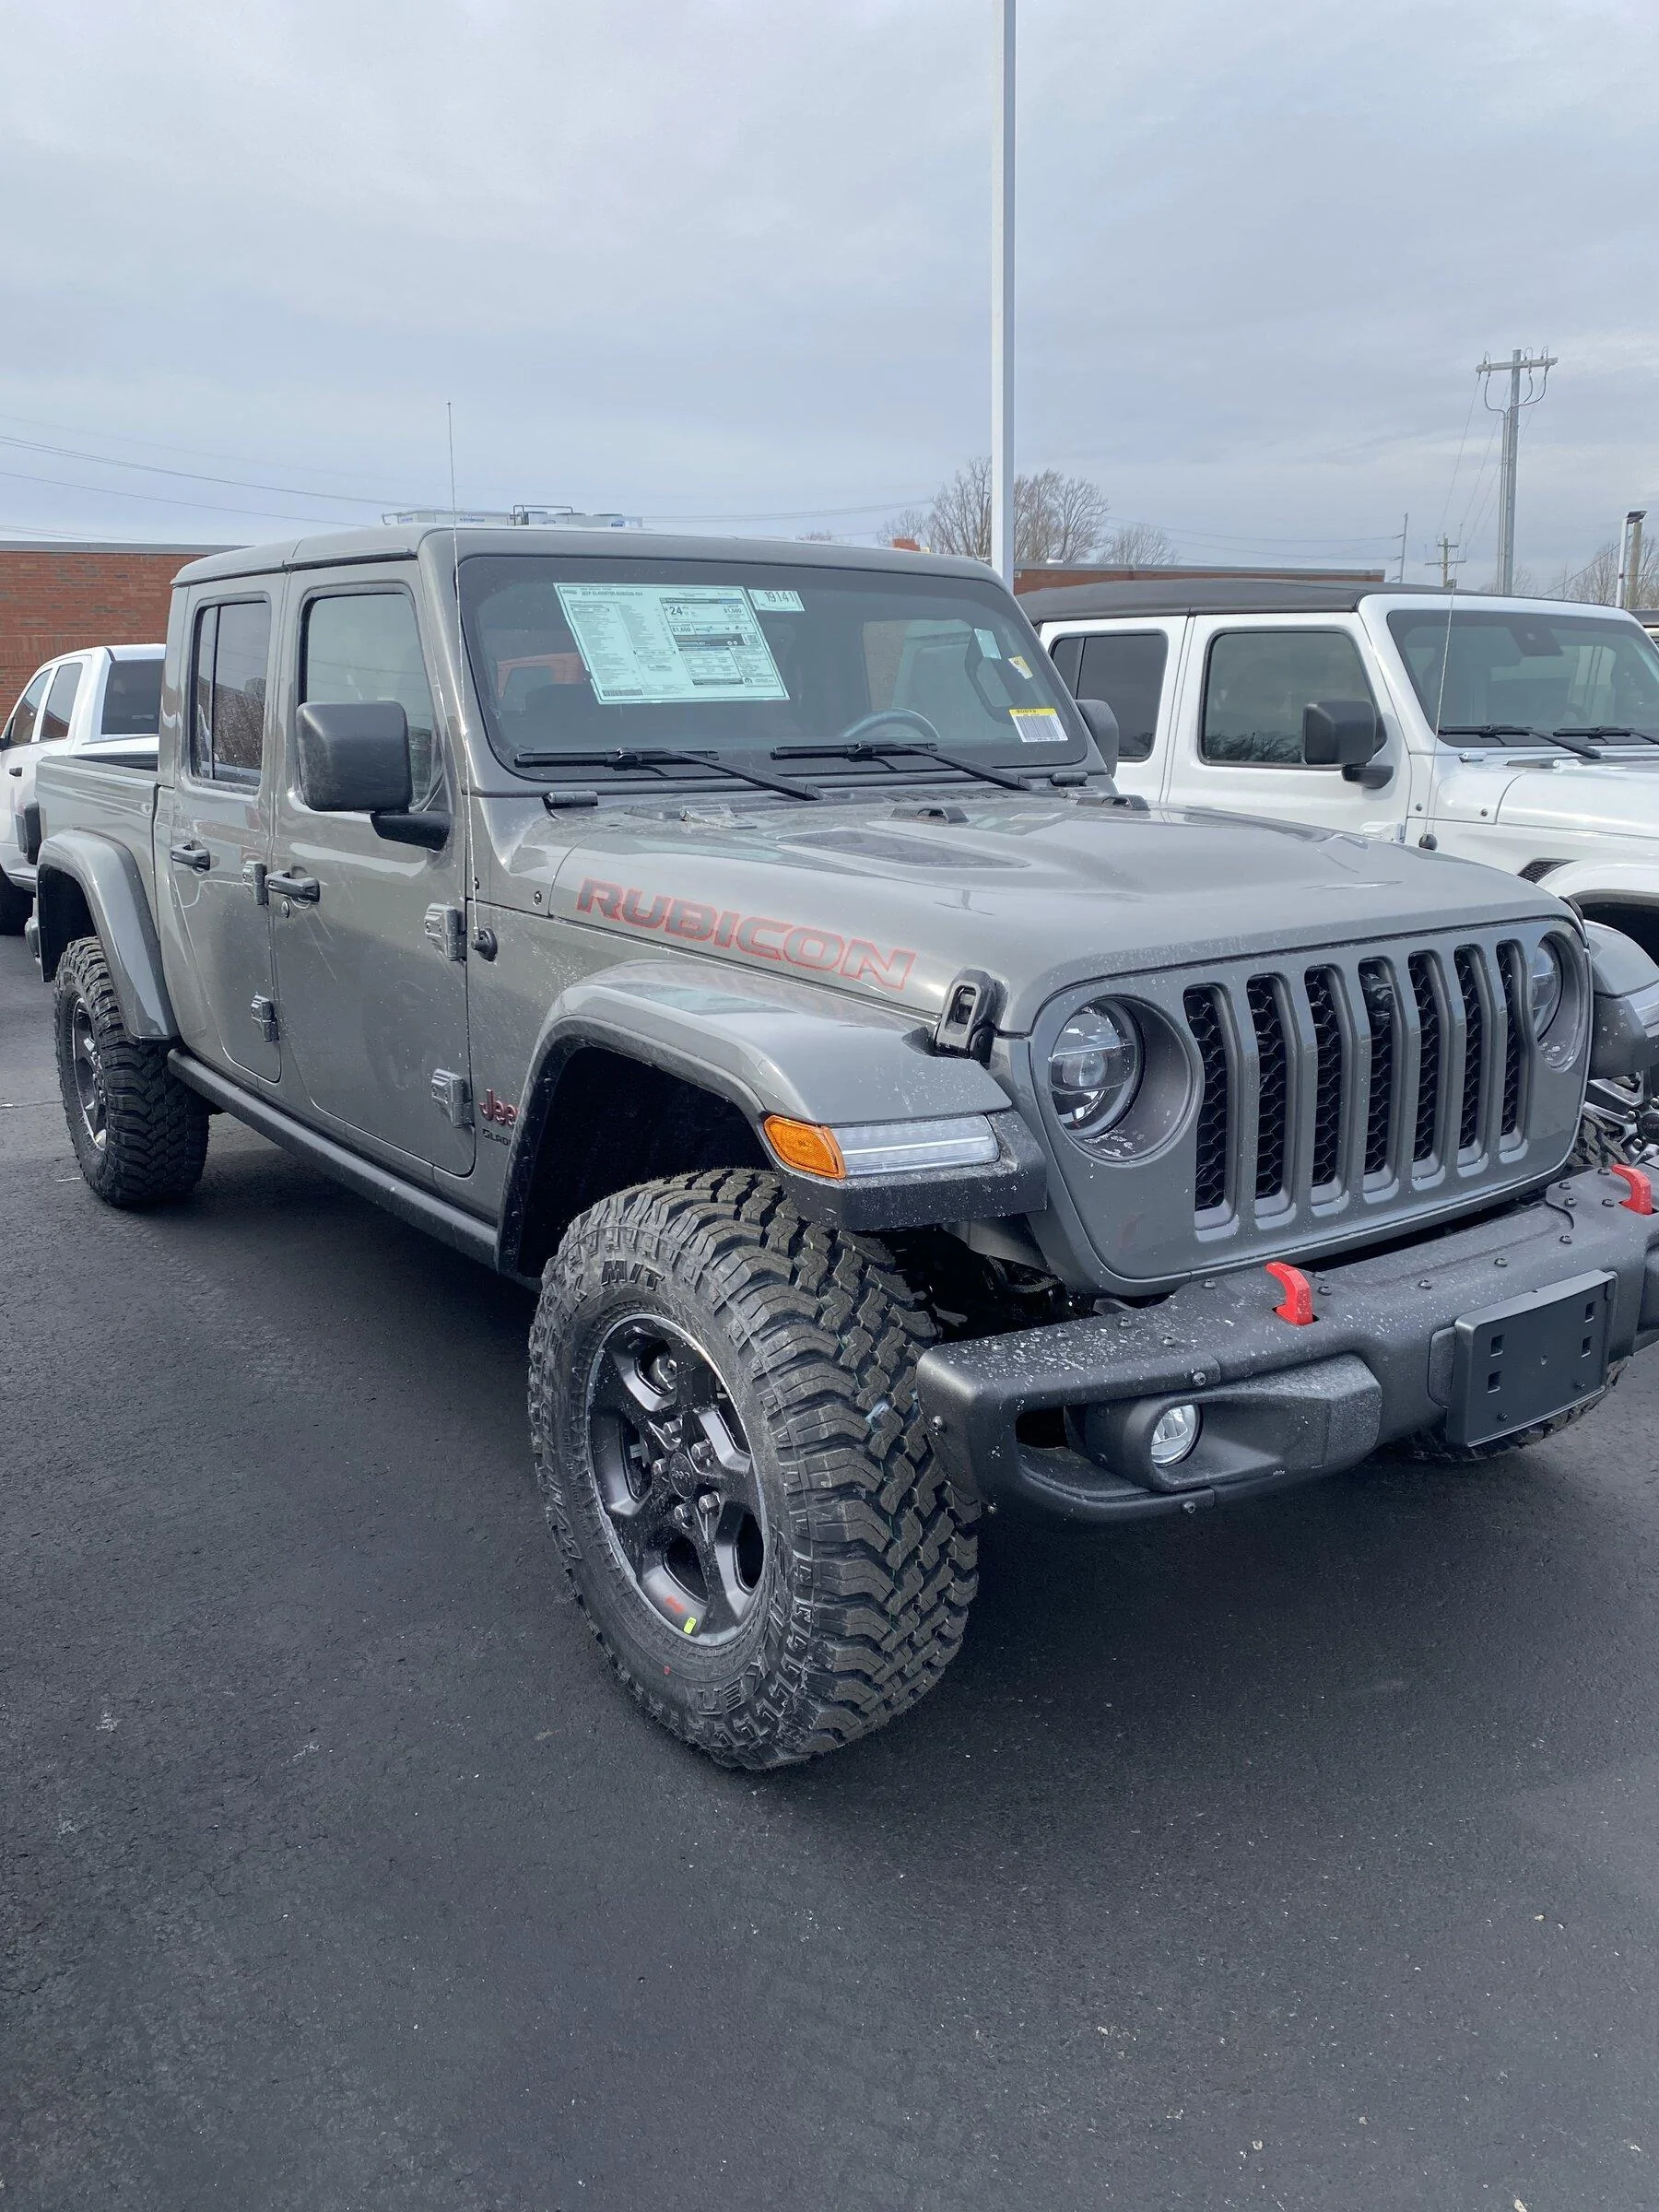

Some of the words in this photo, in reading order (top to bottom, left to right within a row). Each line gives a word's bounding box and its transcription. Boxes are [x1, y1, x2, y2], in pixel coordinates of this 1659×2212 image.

[764, 591, 795, 603] 19141
[669, 606, 683, 616] 24
[576, 877, 917, 991] RUBICON
[479, 1088, 519, 1126] Jee
